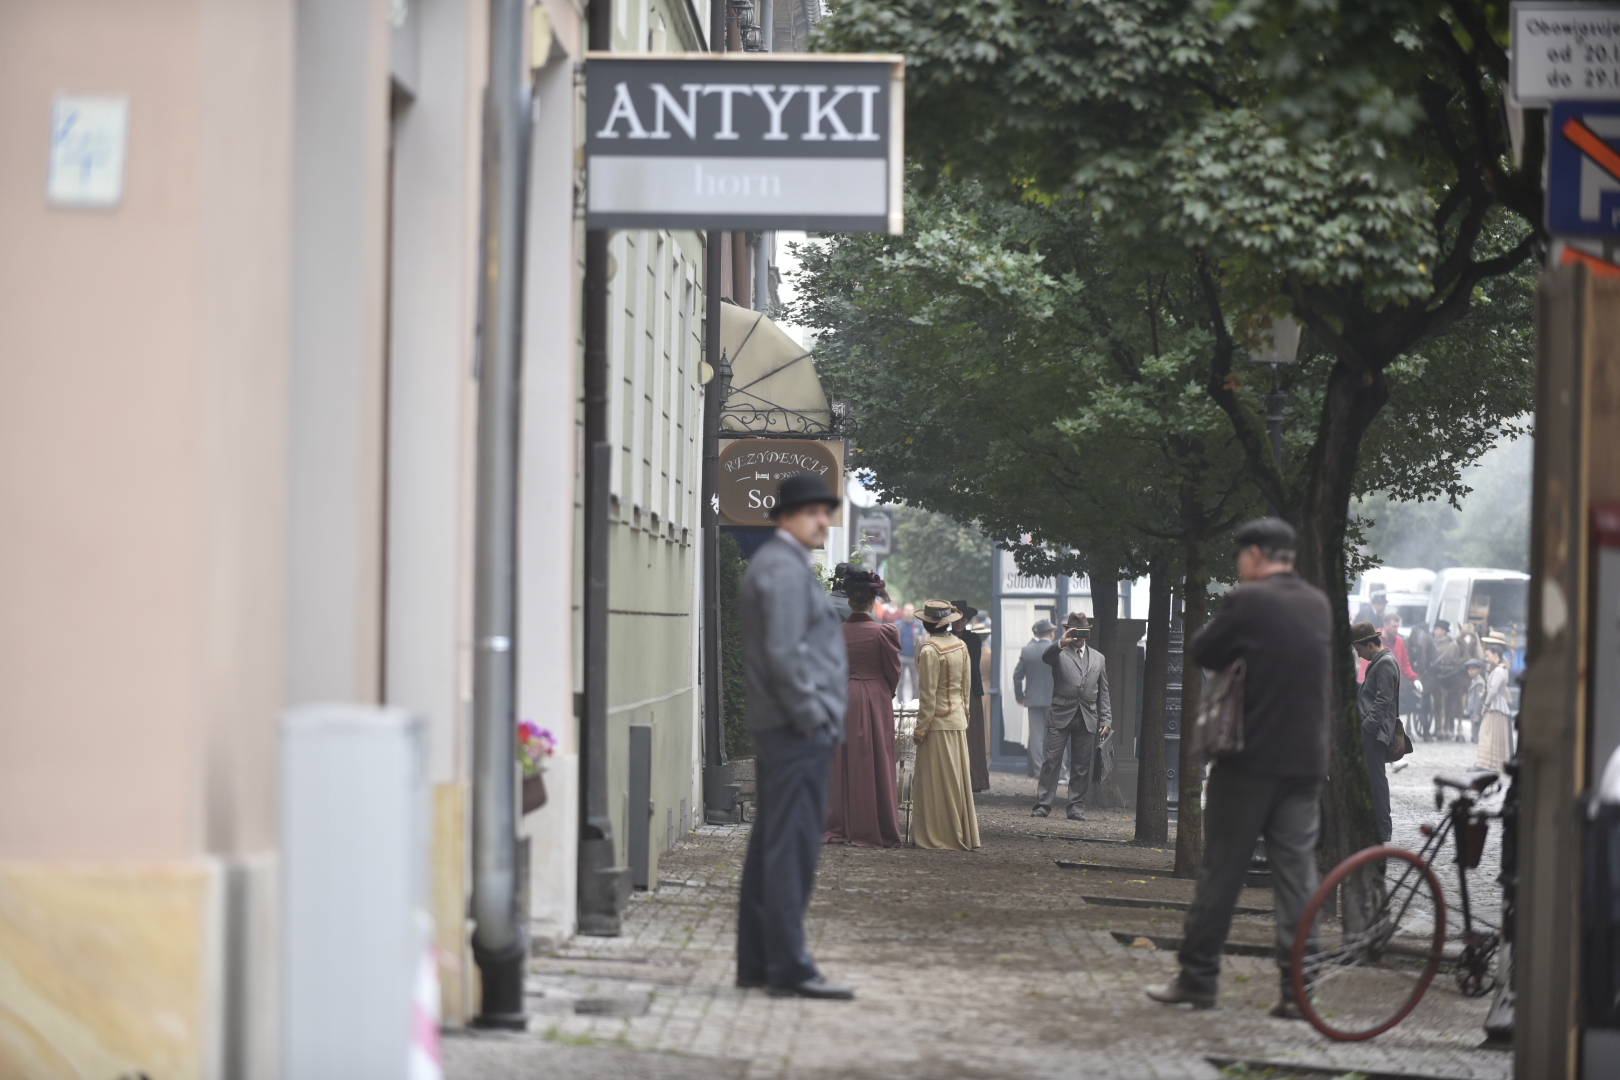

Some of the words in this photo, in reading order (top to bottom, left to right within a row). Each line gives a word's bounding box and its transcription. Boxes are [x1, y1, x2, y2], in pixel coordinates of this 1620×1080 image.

[1547, 44, 1572, 63] od
[1547, 68, 1572, 88] do
[596, 82, 881, 141] ANTYKI
[695, 163, 780, 196] horn
[748, 489, 782, 509] So
